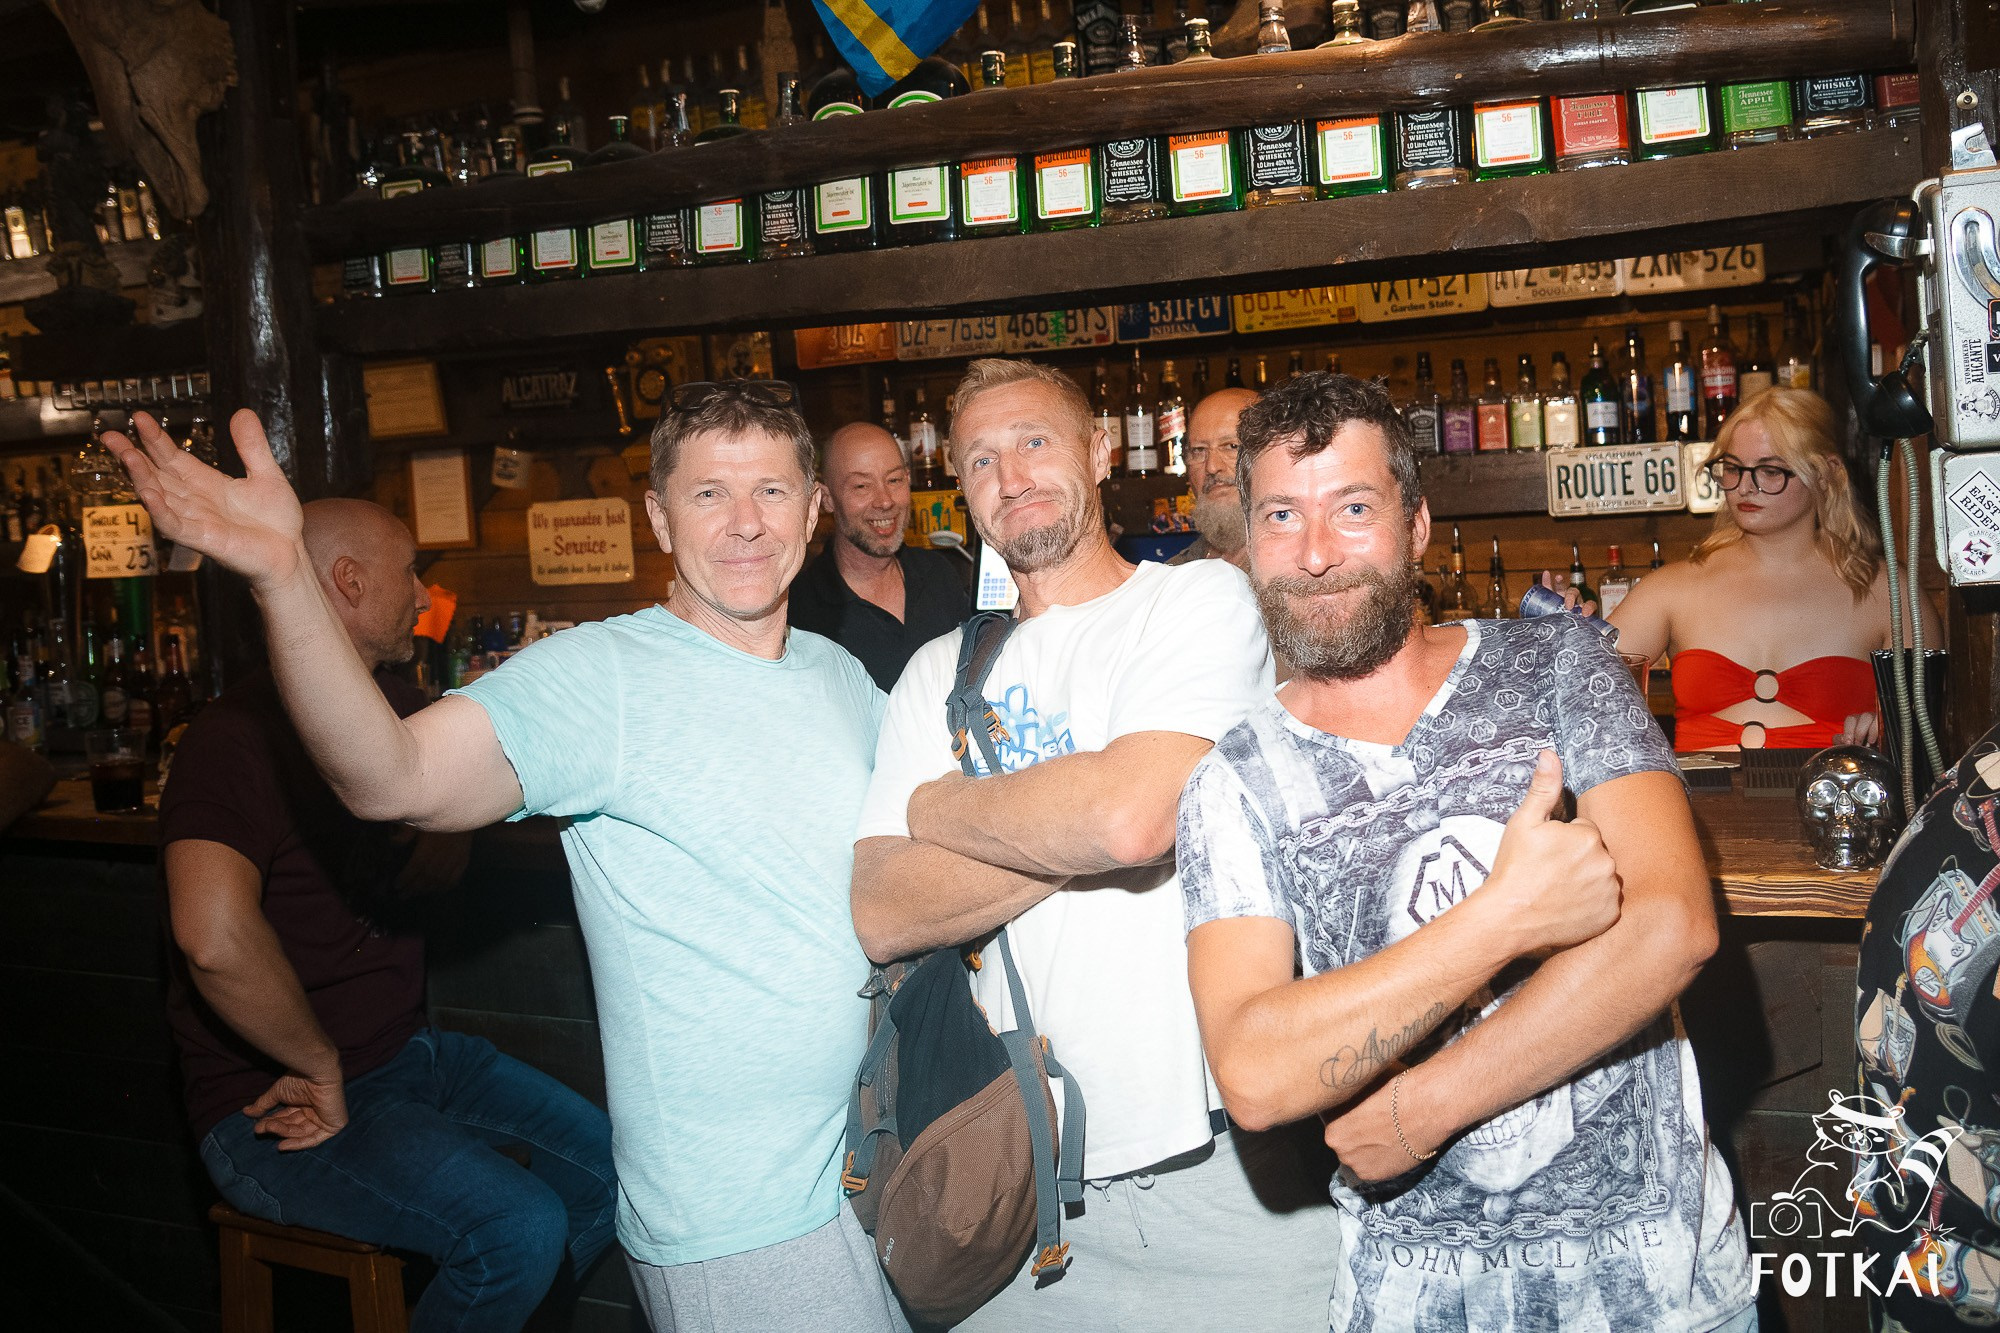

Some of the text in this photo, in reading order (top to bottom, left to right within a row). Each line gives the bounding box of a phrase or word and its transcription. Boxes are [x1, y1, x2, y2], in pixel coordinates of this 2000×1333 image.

[1813, 80, 1857, 92] WHISKEY
[1738, 89, 1774, 99] Tennessee
[1740, 96, 1774, 106] APPLE
[1501, 113, 1512, 123] 56
[1577, 109, 1603, 119] FIRE
[1407, 122, 1445, 132] Tennessee
[1343, 131, 1353, 141] 56
[1408, 131, 1444, 141] WHISKEY
[1257, 142, 1293, 151] Tennessee
[1194, 149, 1204, 159] 56
[1258, 152, 1293, 161] WHISKEY
[1110, 159, 1144, 168] Tennessee
[1058, 168, 1068, 178] 56
[1111, 169, 1144, 178] WHISKEY
[984, 176, 993, 185] 56
[765, 202, 794, 211] Tennessee
[766, 211, 793, 219] WHISKEY
[1390, 299, 1455, 314] Garden State
[1150, 322, 1199, 335] INDIANA
[1969, 338, 1985, 384] ALICANTE
[503, 372, 579, 403] ALCATRAZ
[1556, 457, 1676, 500] ROUTE 66
[1968, 485, 2000, 517] EAST
[125, 511, 140, 536] 4
[554, 534, 608, 556] Service
[1375, 1219, 1662, 1276] JOHN MCLANE
